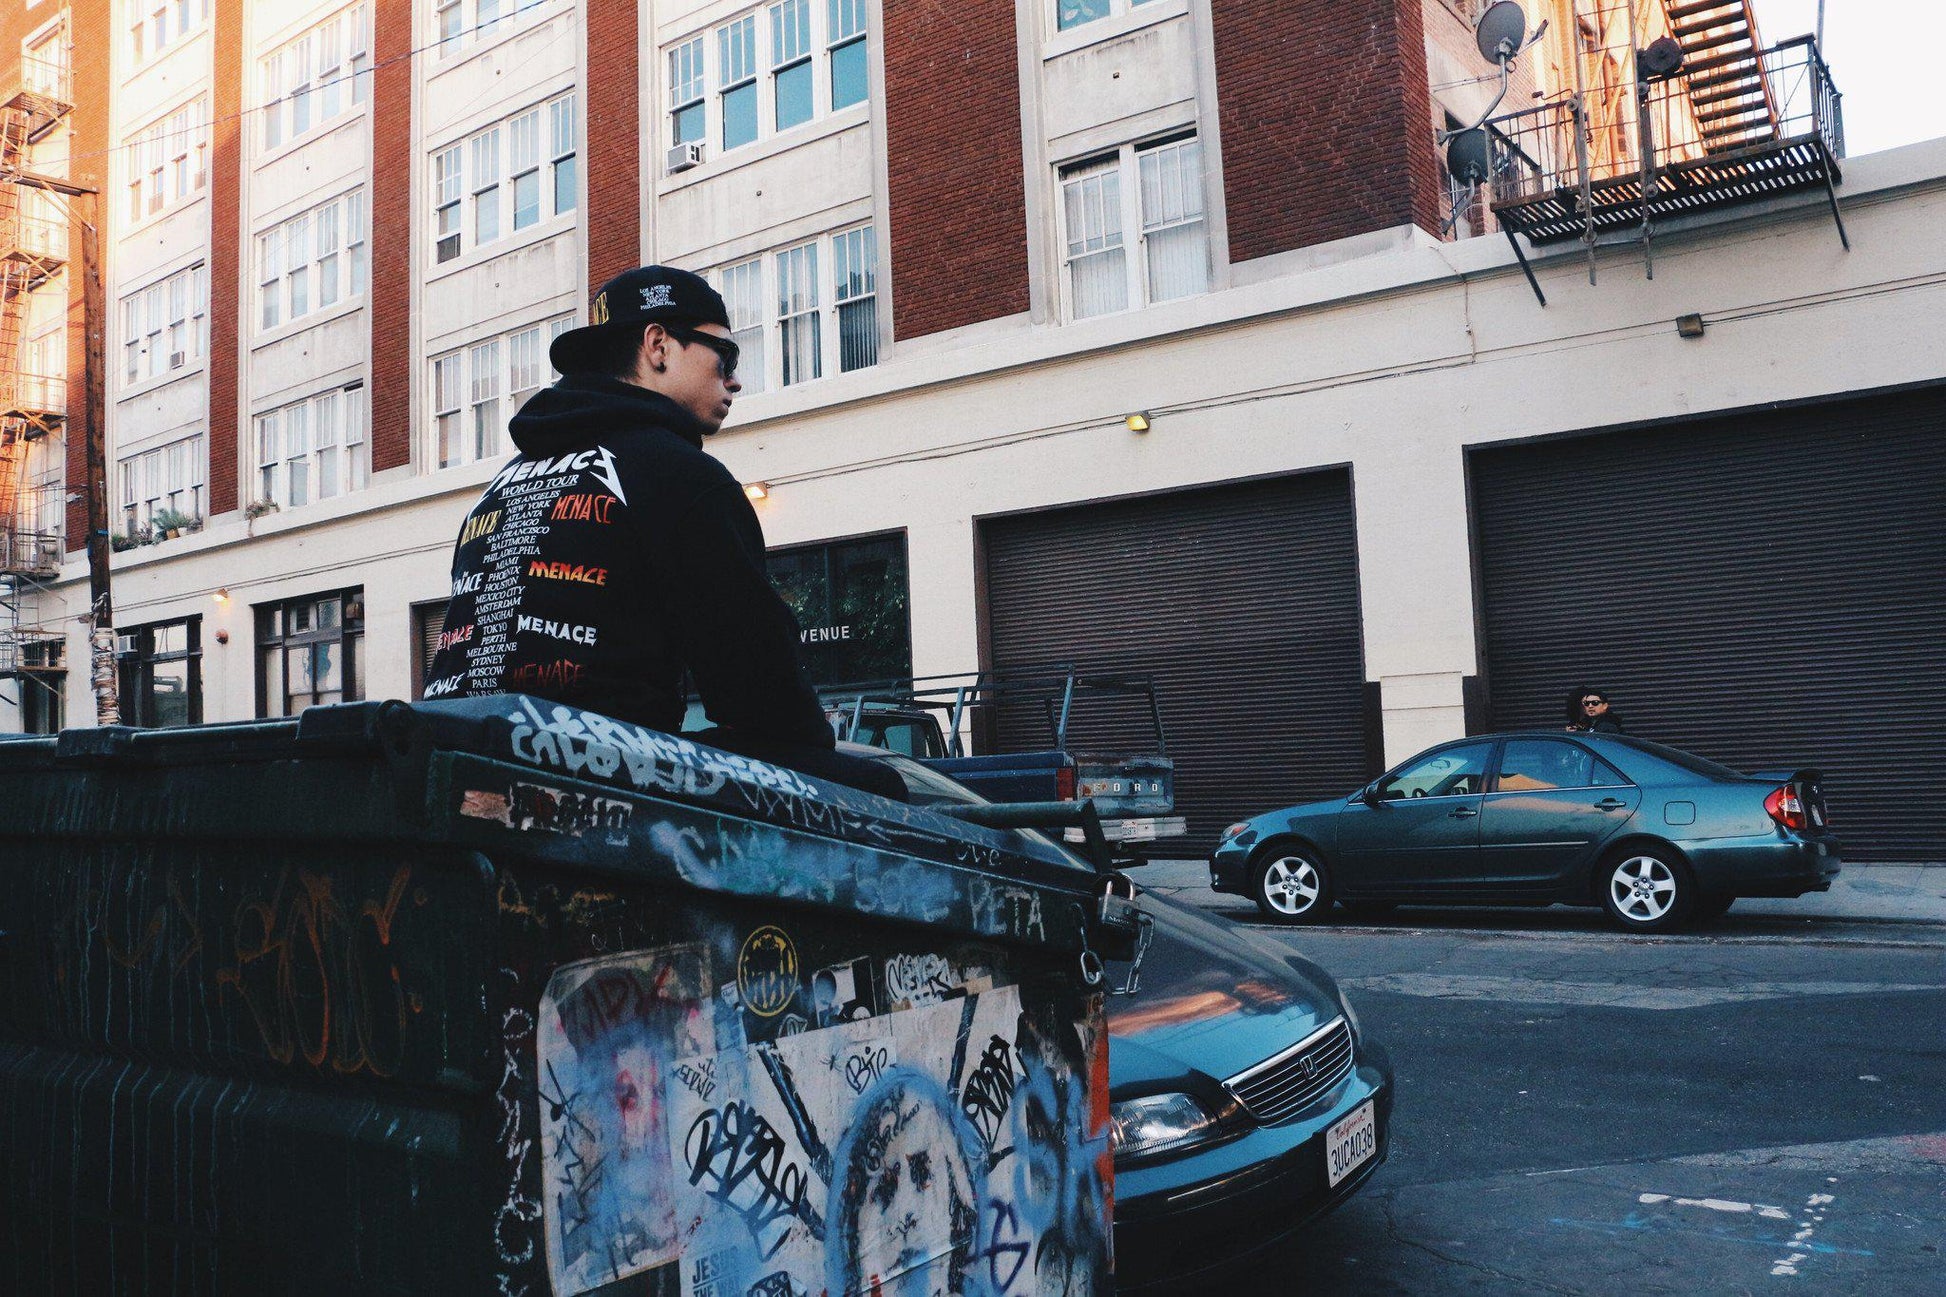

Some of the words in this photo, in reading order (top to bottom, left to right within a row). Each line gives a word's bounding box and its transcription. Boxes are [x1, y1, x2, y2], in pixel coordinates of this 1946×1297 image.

[502, 480, 544, 497] WORLD
[545, 474, 580, 490] TOUR
[505, 496, 523, 508] LOS
[523, 490, 561, 503] ANGELES
[506, 504, 527, 516] NEW
[527, 500, 551, 511] YORK
[505, 510, 543, 524] ATLANTA
[551, 494, 617, 525] MENACE
[502, 518, 540, 532] CHICAGO
[486, 534, 501, 545] SAN
[501, 526, 550, 540] FRANCISCO
[490, 536, 537, 552] BALTIMORE
[482, 546, 541, 564] PHILADELPHIA
[495, 556, 519, 571] MIAMI
[487, 565, 522, 582] PHOENIX
[528, 560, 608, 587] MENACE
[484, 575, 520, 593] HOUSTON
[475, 589, 506, 605] MEXICO
[505, 585, 526, 598] CITY
[474, 596, 522, 616] AMSTERDAM
[477, 608, 514, 626] SHANGHAI
[482, 622, 508, 636] TOKYO
[515, 614, 598, 647] MENACE
[800, 625, 850, 643] VENUE
[480, 633, 507, 646] PERTH
[465, 641, 518, 659] MELBOURNE
[470, 654, 506, 668] SYDNEY
[467, 665, 506, 679] MOSCOW
[472, 678, 498, 689] PARIS
[1093, 782, 1158, 792] FORD
[1331, 1122, 1373, 1176] 3UCA038
